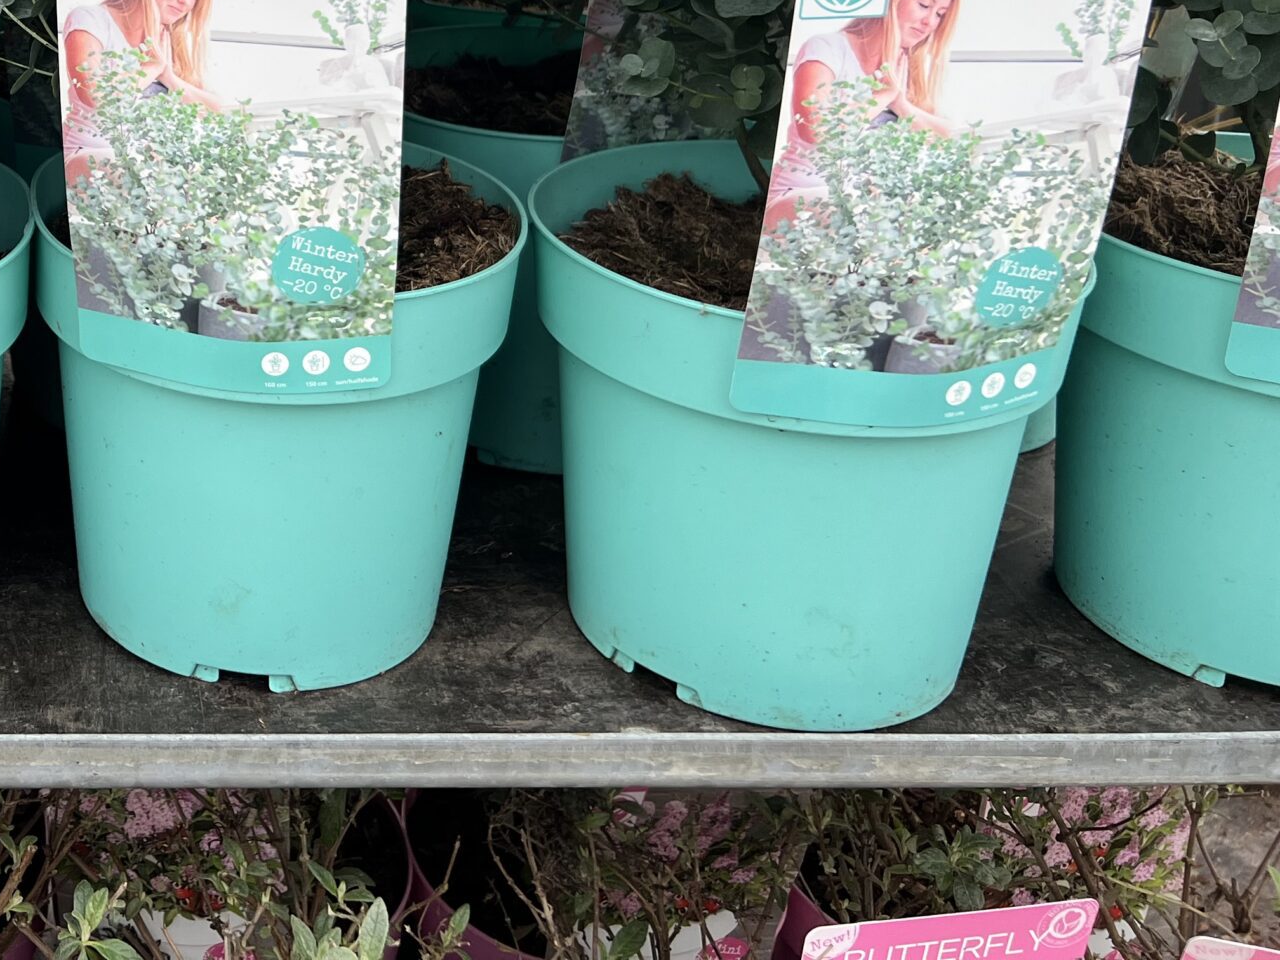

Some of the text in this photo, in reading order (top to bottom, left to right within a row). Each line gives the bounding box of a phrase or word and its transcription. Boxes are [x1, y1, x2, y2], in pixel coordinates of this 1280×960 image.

[291, 235, 359, 263] Winter
[288, 256, 347, 284] Hardy
[999, 258, 1058, 281] Winter
[282, 279, 317, 295] -20
[991, 281, 1045, 304] Hardy
[983, 303, 1014, 318] -20
[810, 929, 851, 952] New!
